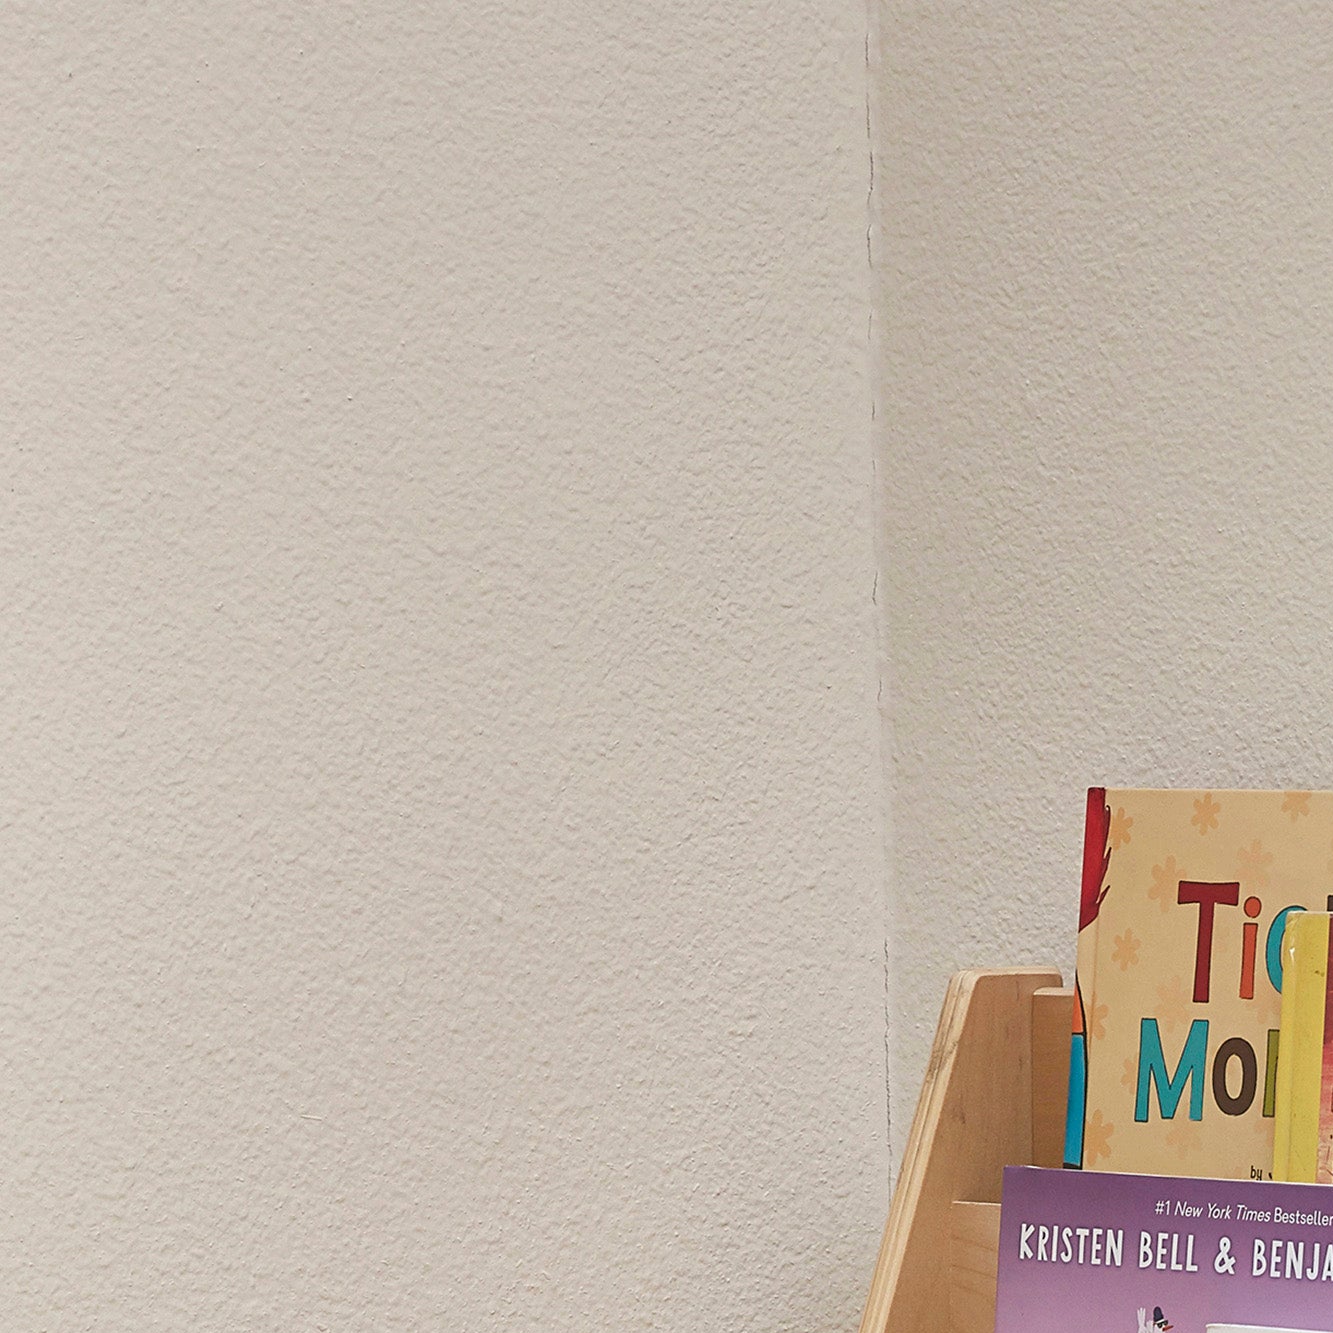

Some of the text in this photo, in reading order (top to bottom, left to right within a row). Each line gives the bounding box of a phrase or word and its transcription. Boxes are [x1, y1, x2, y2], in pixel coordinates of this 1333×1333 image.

[1250, 1164, 1263, 1181] by
[1154, 1200, 1171, 1216] #1
[1174, 1201, 1204, 1218] New
[1207, 1203, 1232, 1220] York
[1236, 1204, 1272, 1223] Times
[1019, 1222, 1124, 1266] KRISTEN
[1138, 1231, 1199, 1272] BELL
[1214, 1236, 1237, 1276] &
